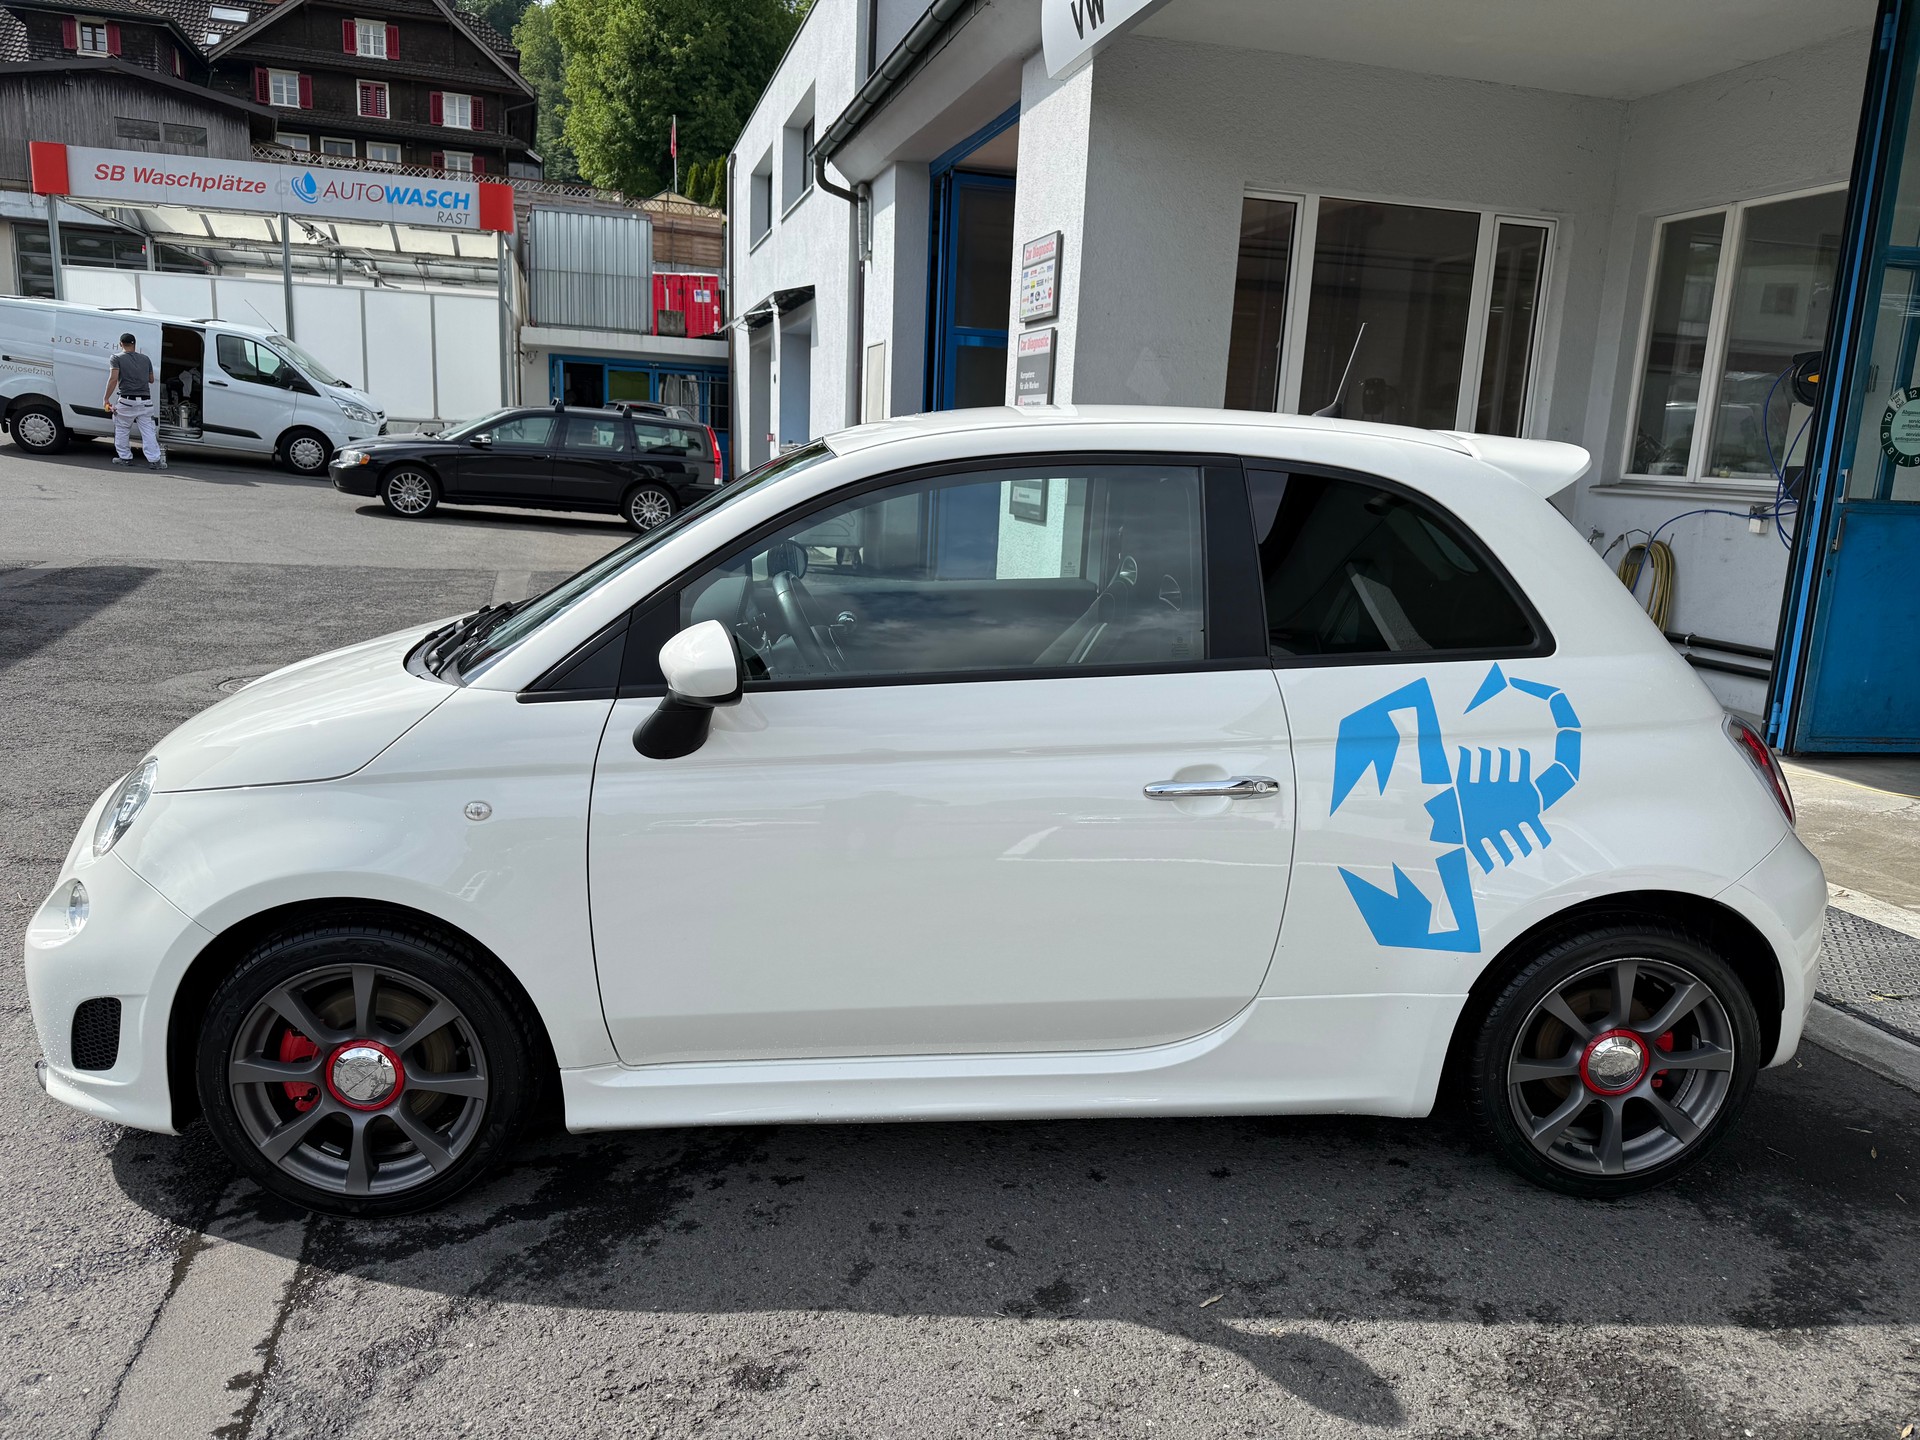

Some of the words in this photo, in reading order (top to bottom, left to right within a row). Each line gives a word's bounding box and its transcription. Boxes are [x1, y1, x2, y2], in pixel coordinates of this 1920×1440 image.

[1070, 0, 1105, 40] VW
[94, 163, 126, 182] SB
[132, 166, 267, 194] Waschplätze
[323, 180, 471, 210] AUTOWASCH
[436, 211, 471, 225] RAST
[1032, 240, 1055, 259] Diagnostic
[57, 335, 98, 347] JOSEF
[1020, 340, 1028, 352] Car
[1028, 335, 1049, 352] Diagnostic
[1909, 390, 1917, 398] 12
[1884, 412, 1893, 422] 10
[1899, 456, 1904, 464] 7
[1914, 456, 1920, 465] 6
